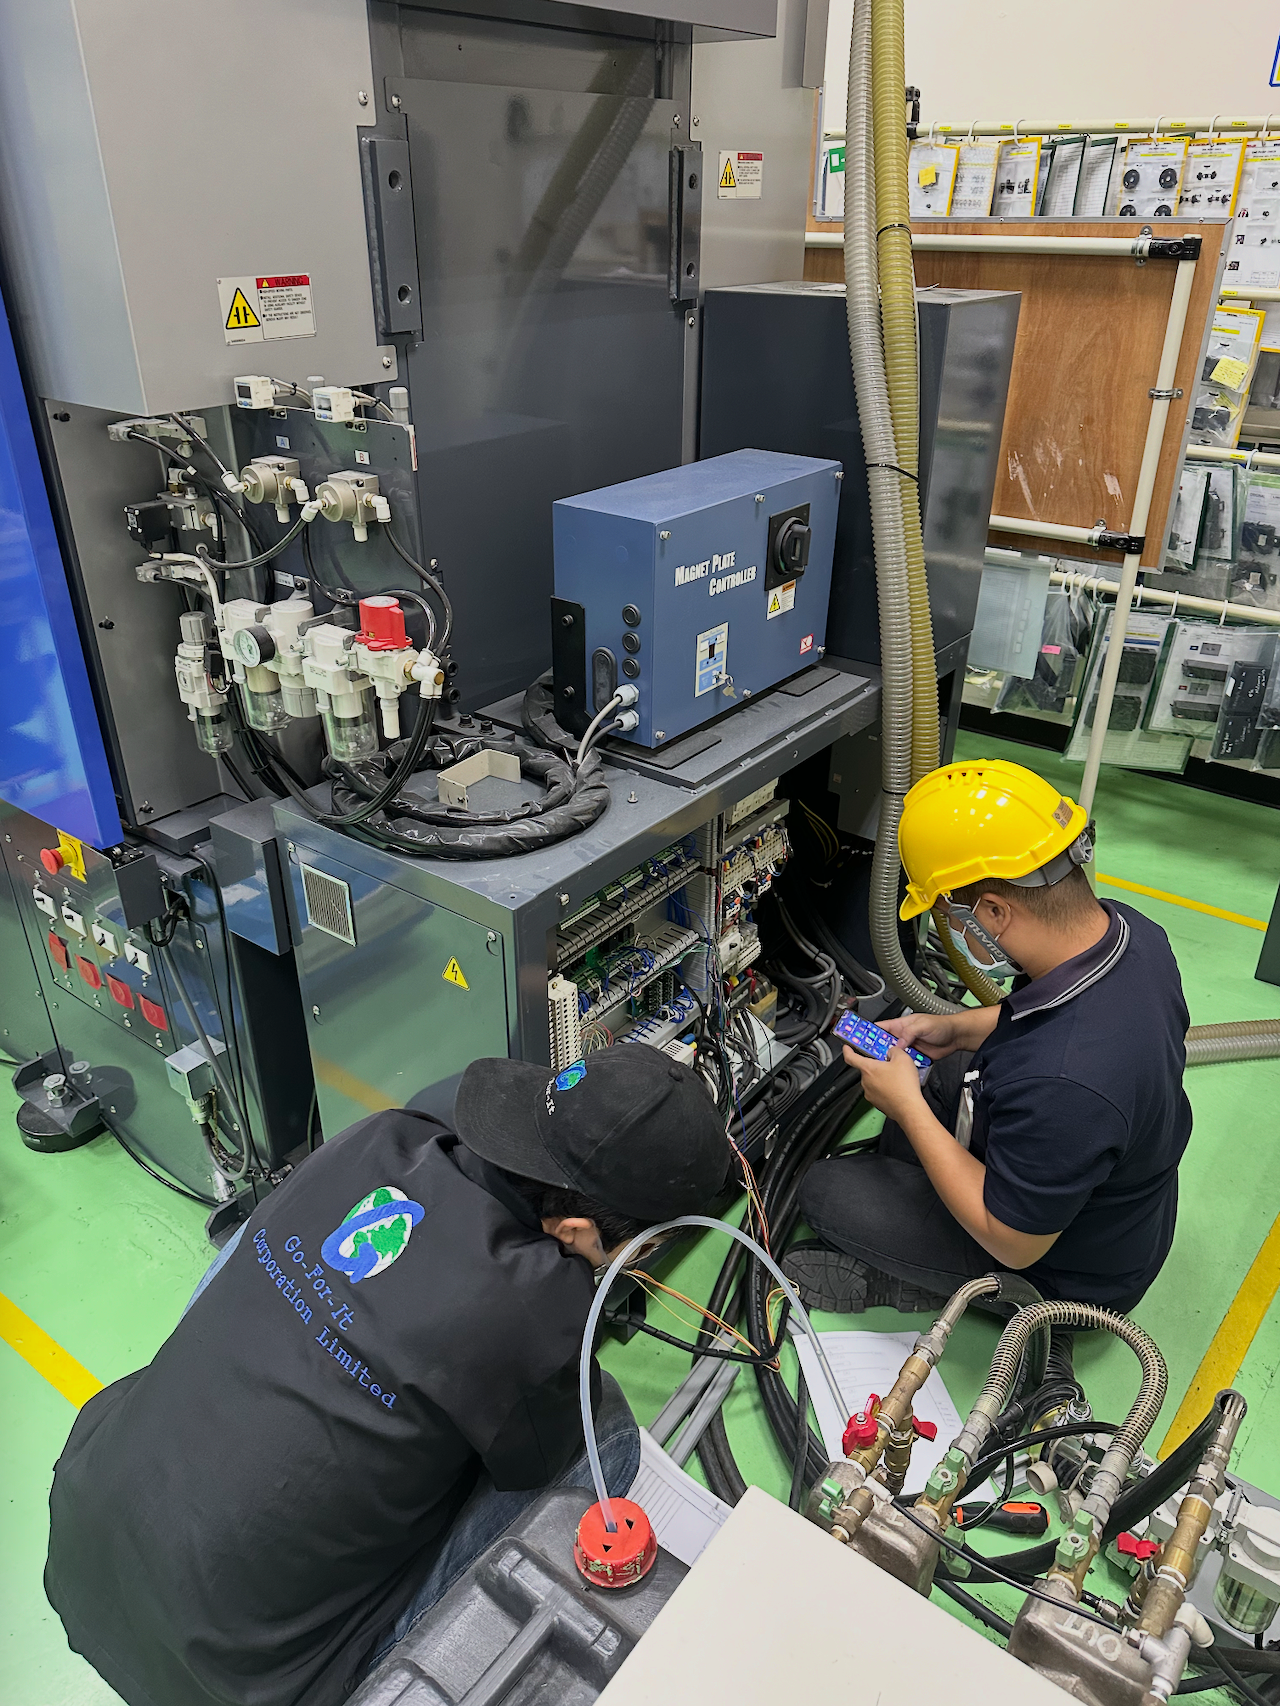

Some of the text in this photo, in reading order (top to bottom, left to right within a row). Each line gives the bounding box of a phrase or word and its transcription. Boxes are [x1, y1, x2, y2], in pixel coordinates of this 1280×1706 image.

[280, 439, 286, 447] A
[359, 453, 365, 462] B
[674, 551, 736, 587] MAGNET PLATE
[708, 565, 758, 597] CONTROLLER
[965, 919, 1010, 961] GUARD
[284, 1234, 355, 1331] Go-For-It
[252, 1228, 397, 1409] Corporation Limited
